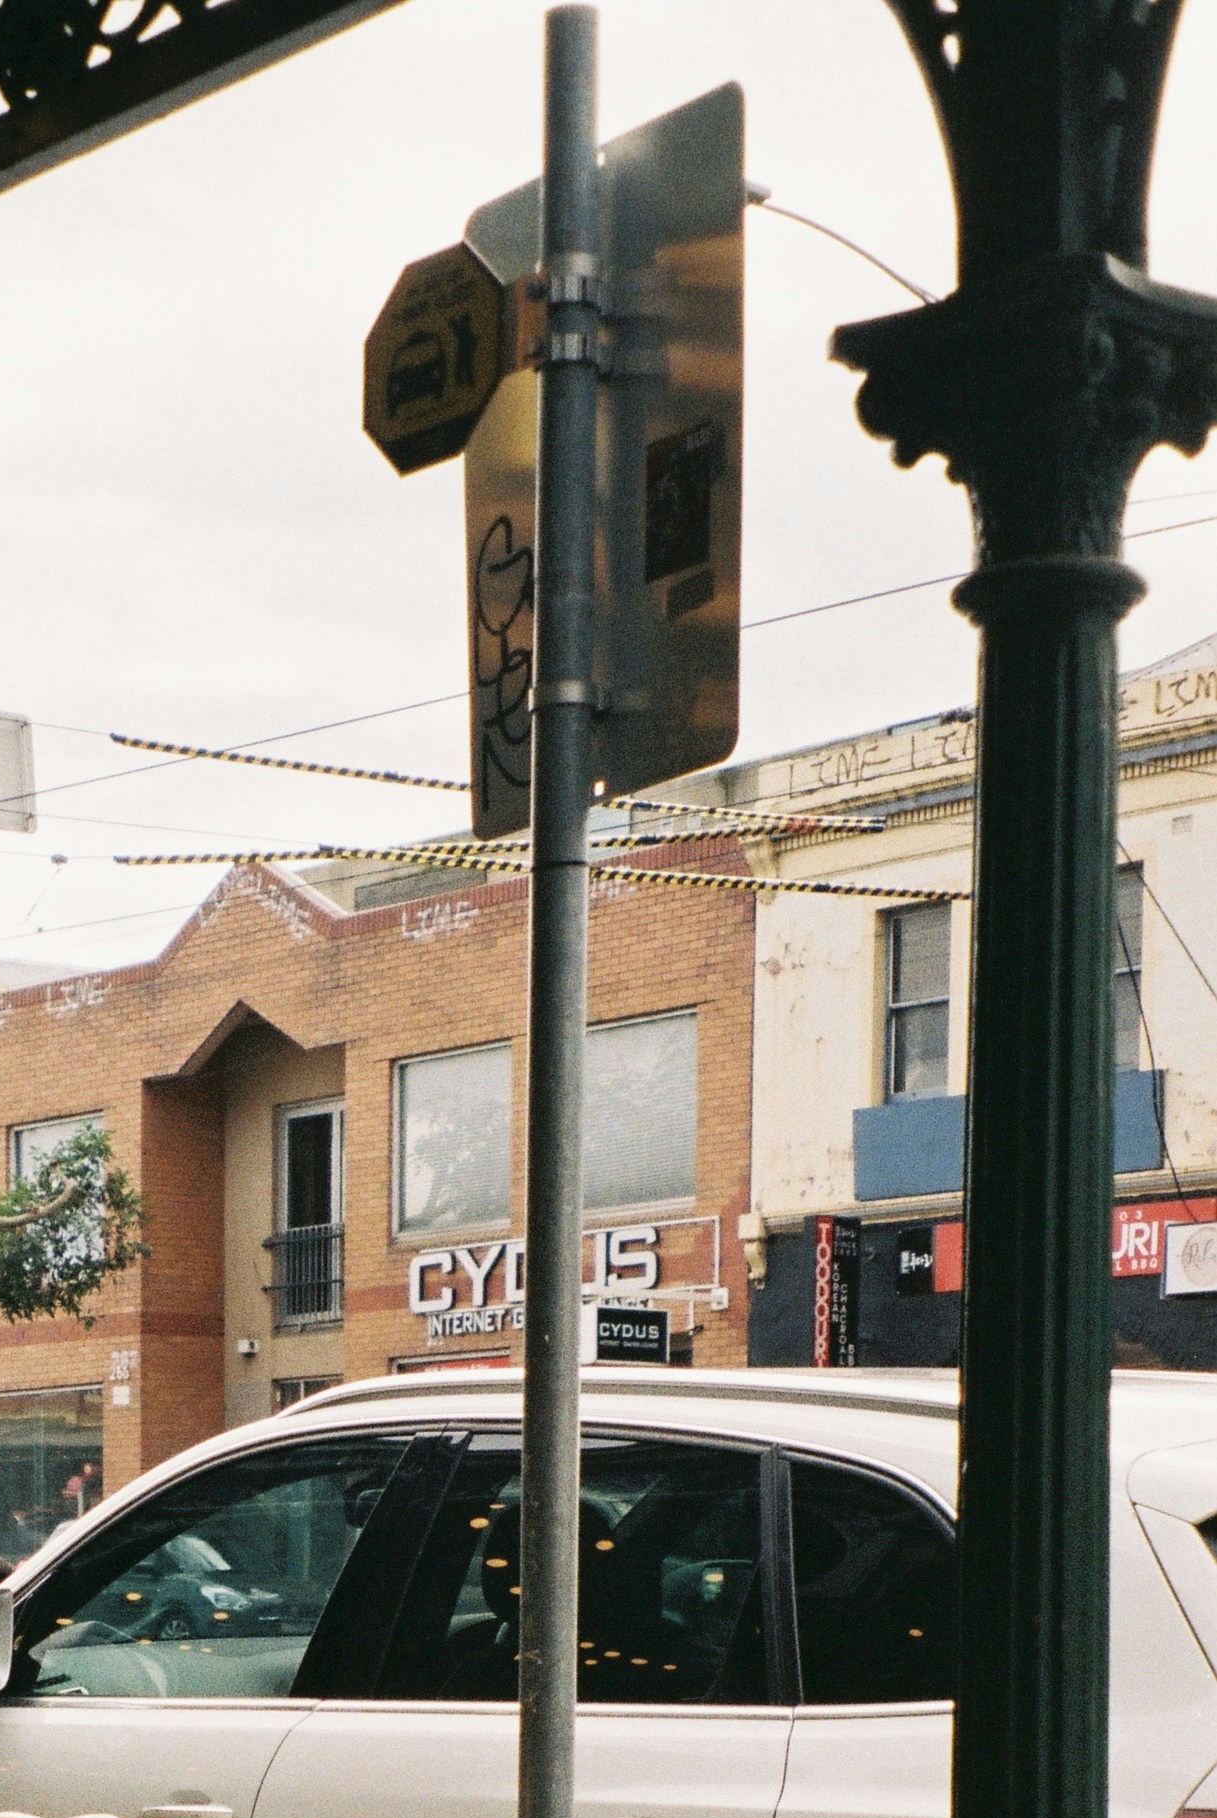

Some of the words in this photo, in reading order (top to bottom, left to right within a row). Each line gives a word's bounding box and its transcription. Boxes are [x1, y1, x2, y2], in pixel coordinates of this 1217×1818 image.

[409, 1227, 657, 1314] CYS
[427, 1309, 506, 1337] INTERNET
[598, 1322, 660, 1340] CYDUS
